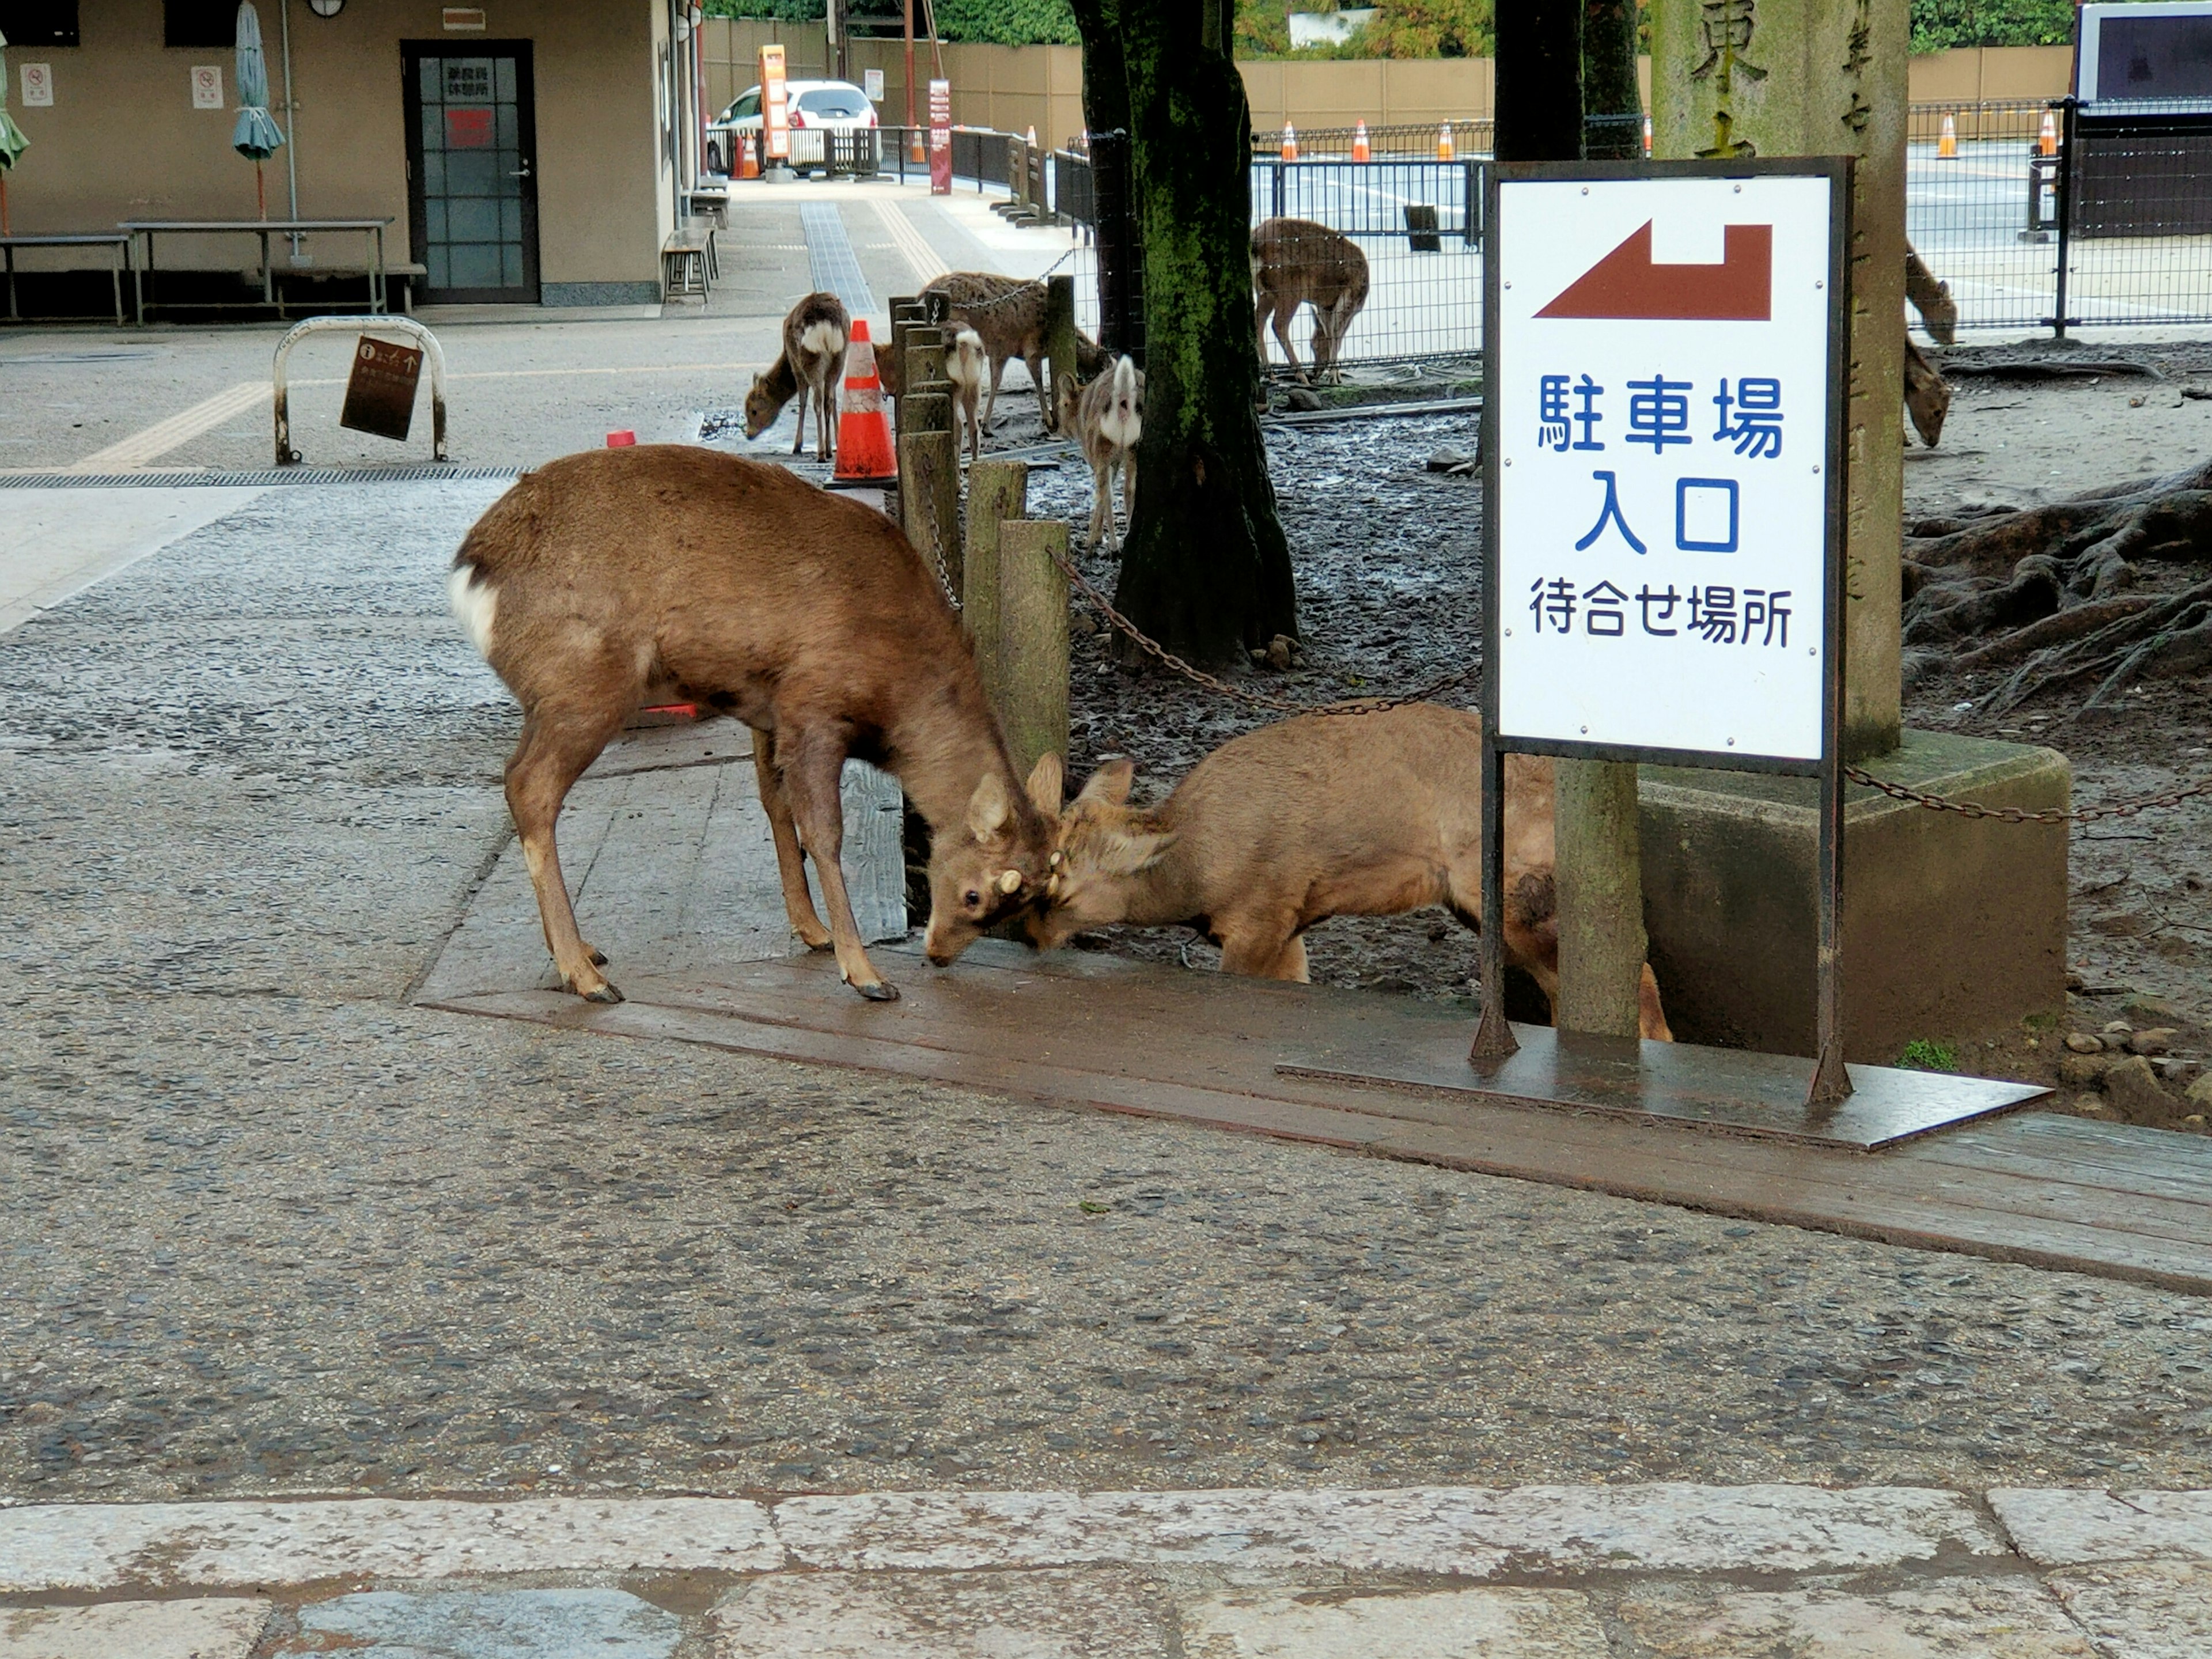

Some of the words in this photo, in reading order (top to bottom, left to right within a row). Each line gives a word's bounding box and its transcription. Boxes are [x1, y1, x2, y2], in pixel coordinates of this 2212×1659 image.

[1539, 374, 1783, 458] 駐車場
[1575, 471, 1738, 554] 入口
[1530, 577, 1791, 647] 待合せ場所
